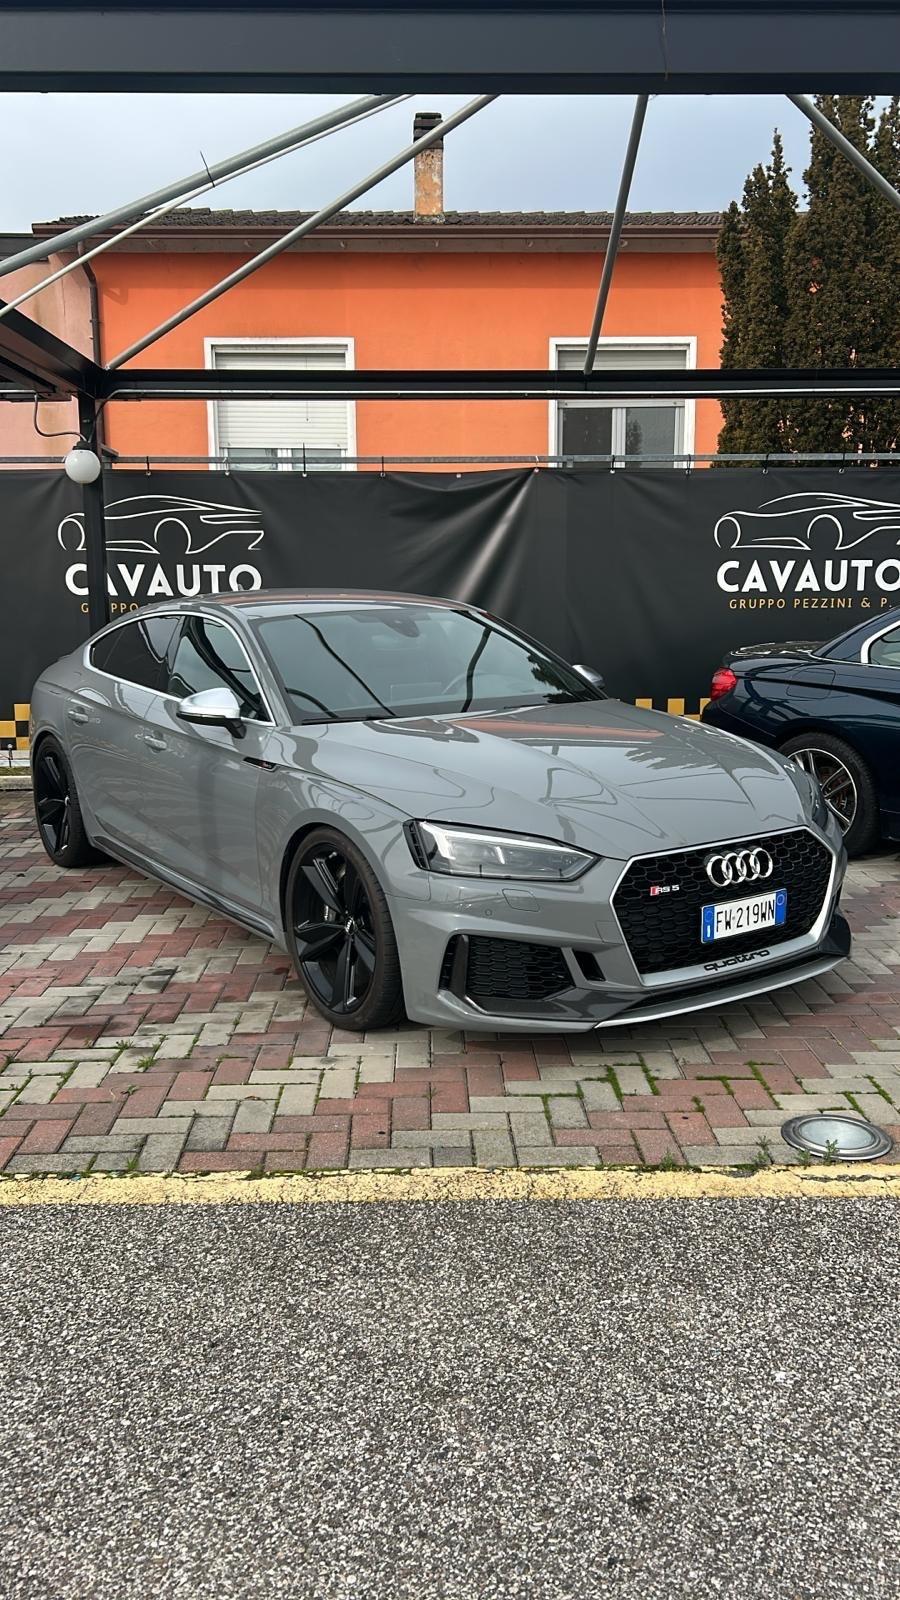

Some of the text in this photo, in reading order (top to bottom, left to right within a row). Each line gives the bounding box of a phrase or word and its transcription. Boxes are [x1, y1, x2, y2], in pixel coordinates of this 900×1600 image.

[716, 558, 900, 593] CAVAUTO
[80, 602, 139, 614] GPPO
[729, 599, 786, 609] GRUPPO
[793, 598, 852, 608] PEZZINI
[860, 597, 871, 608] &
[703, 949, 770, 971] quattro
